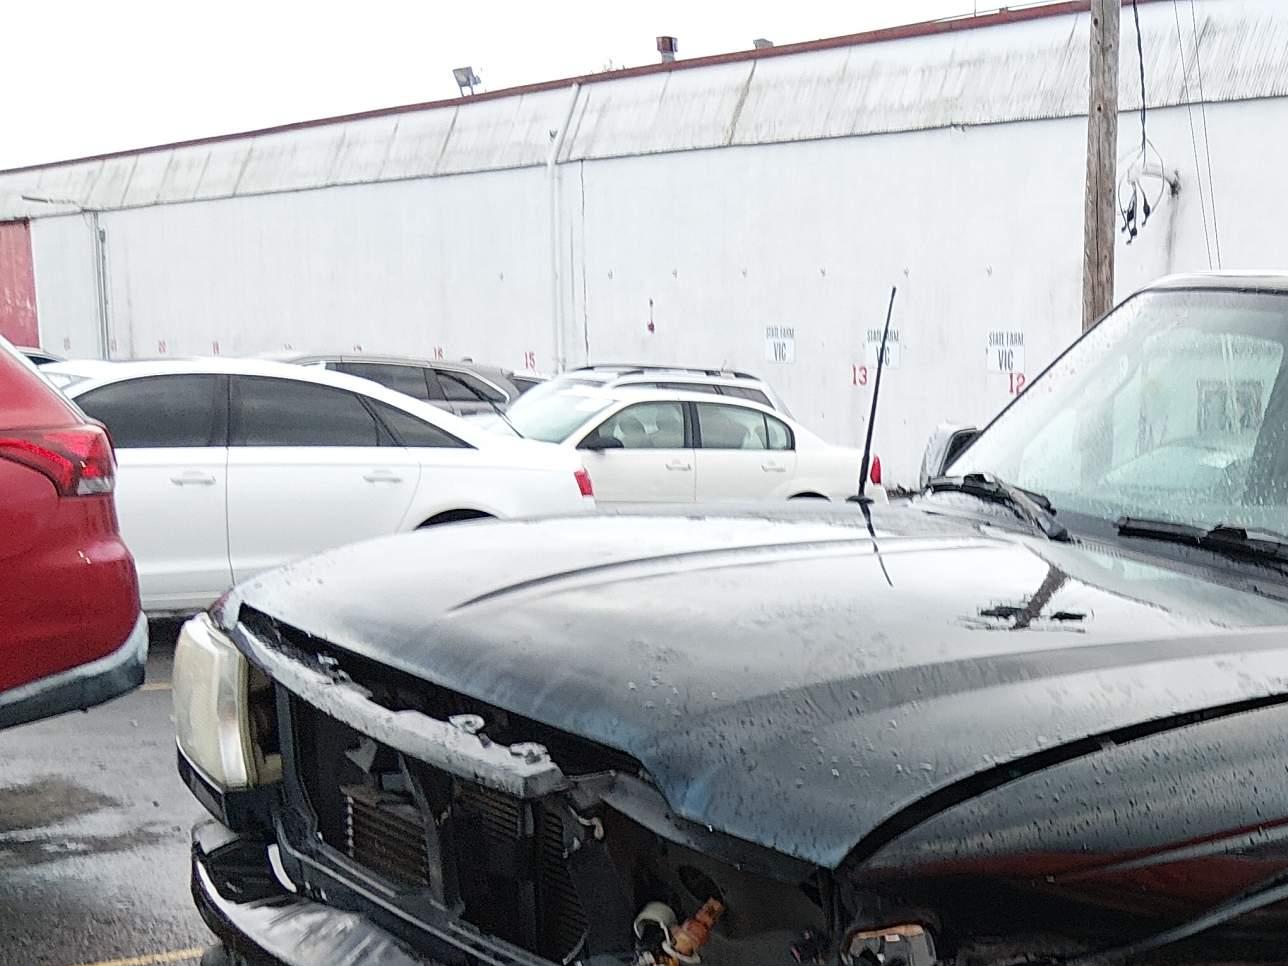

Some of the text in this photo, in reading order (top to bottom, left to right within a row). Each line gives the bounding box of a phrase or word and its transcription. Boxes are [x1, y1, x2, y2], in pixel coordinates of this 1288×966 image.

[875, 345, 890, 367] VC
[998, 349, 1014, 371] VIC
[852, 364, 868, 386] 13
